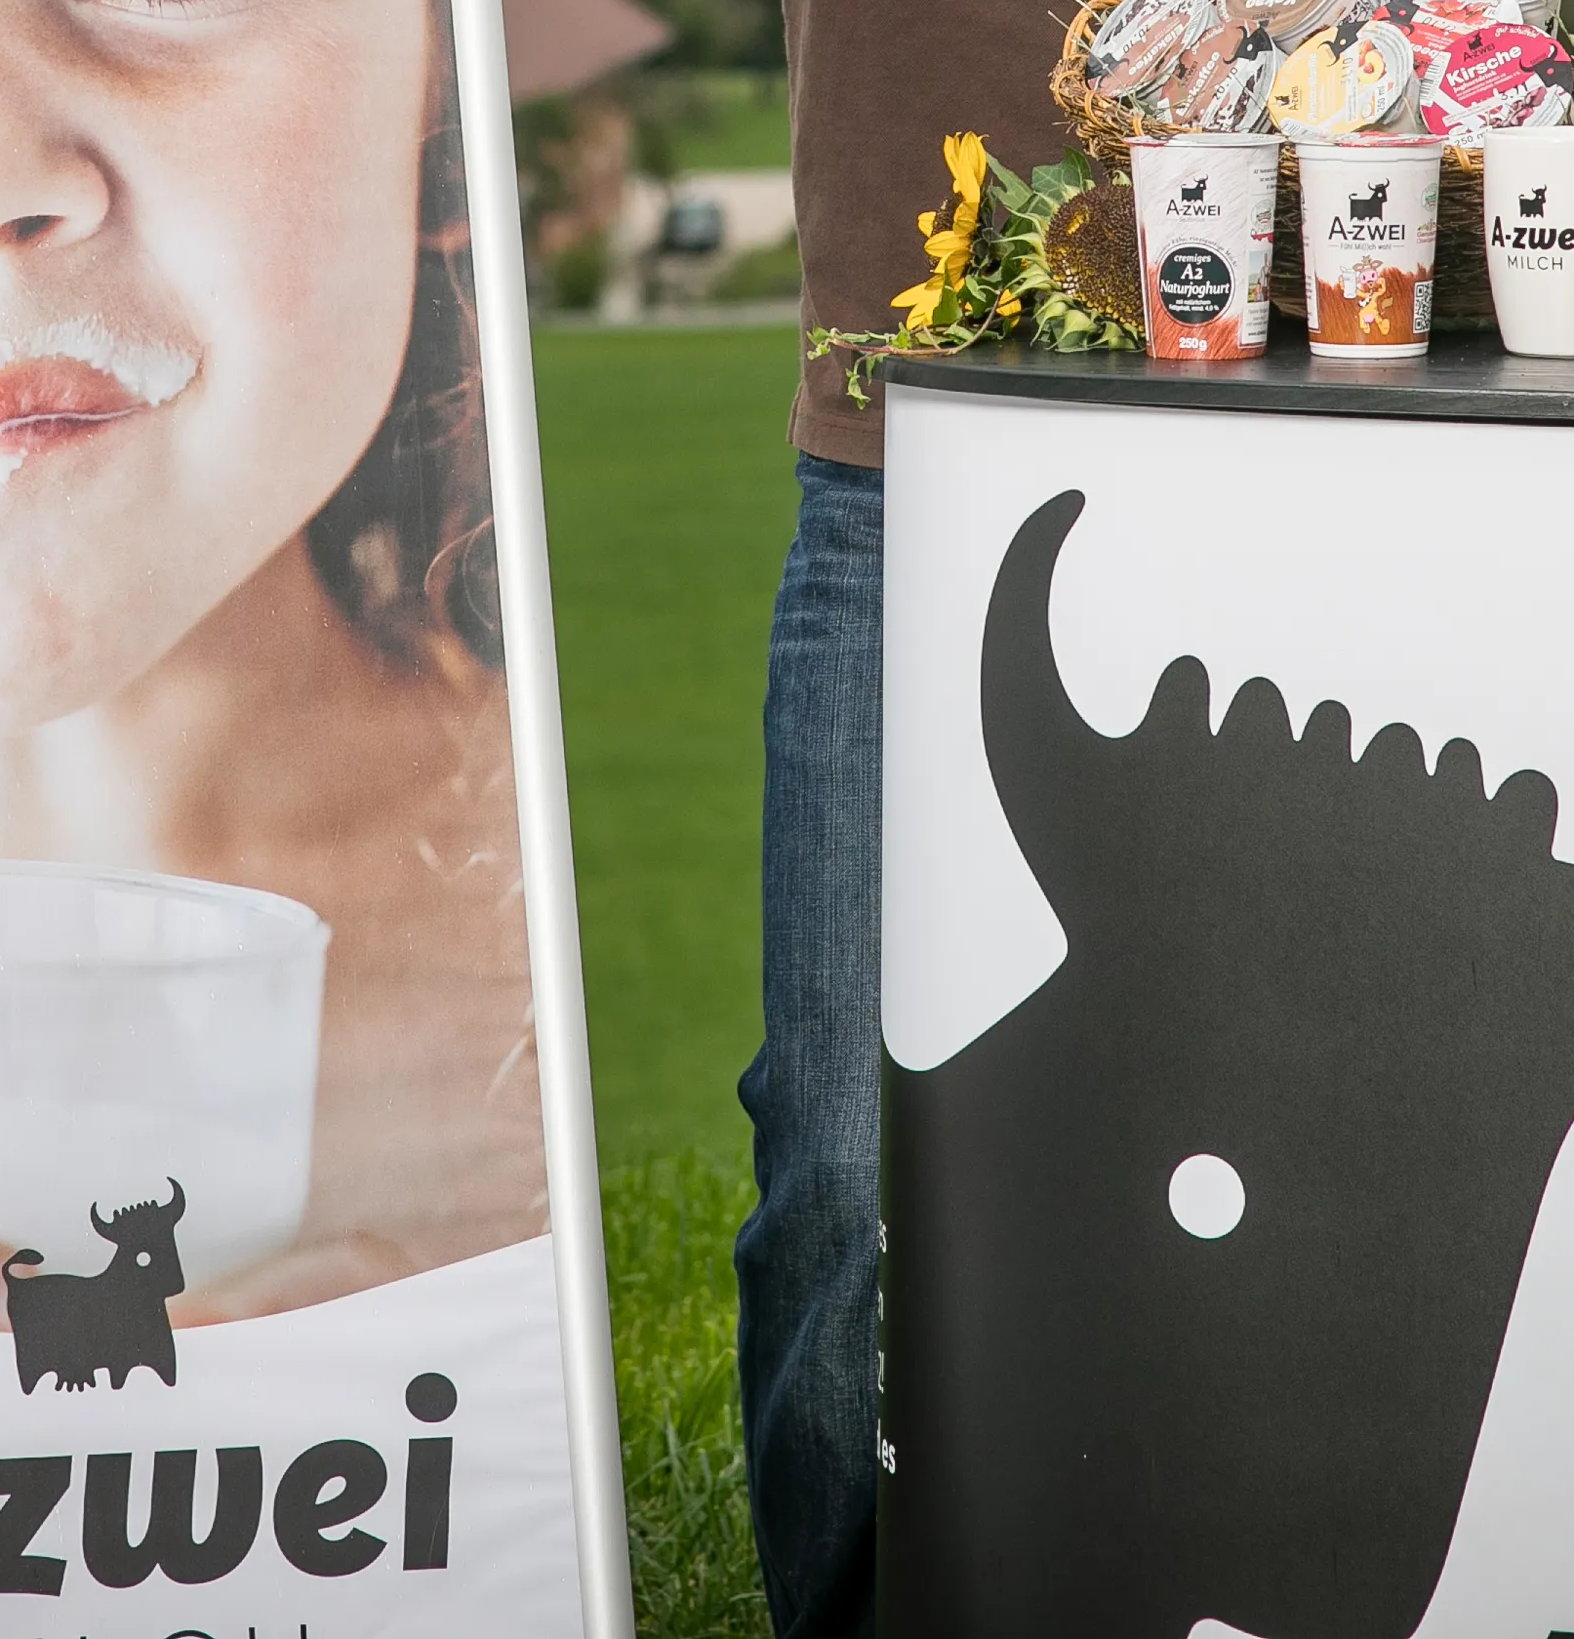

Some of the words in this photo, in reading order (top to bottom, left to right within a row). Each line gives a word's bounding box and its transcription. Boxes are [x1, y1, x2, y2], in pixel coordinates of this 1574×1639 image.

[1446, 44, 1523, 87] Kirsche
[1376, 93, 1385, 111] 250
[1455, 135, 1475, 147] 250
[1166, 199, 1221, 216] A-ZWEI
[1328, 216, 1405, 241] A-ZWEI
[1174, 254, 1212, 265] cremiges
[1507, 255, 1564, 271] MILCH
[1181, 264, 1203, 279] A2
[1160, 280, 1229, 298] Naturjoghurt
